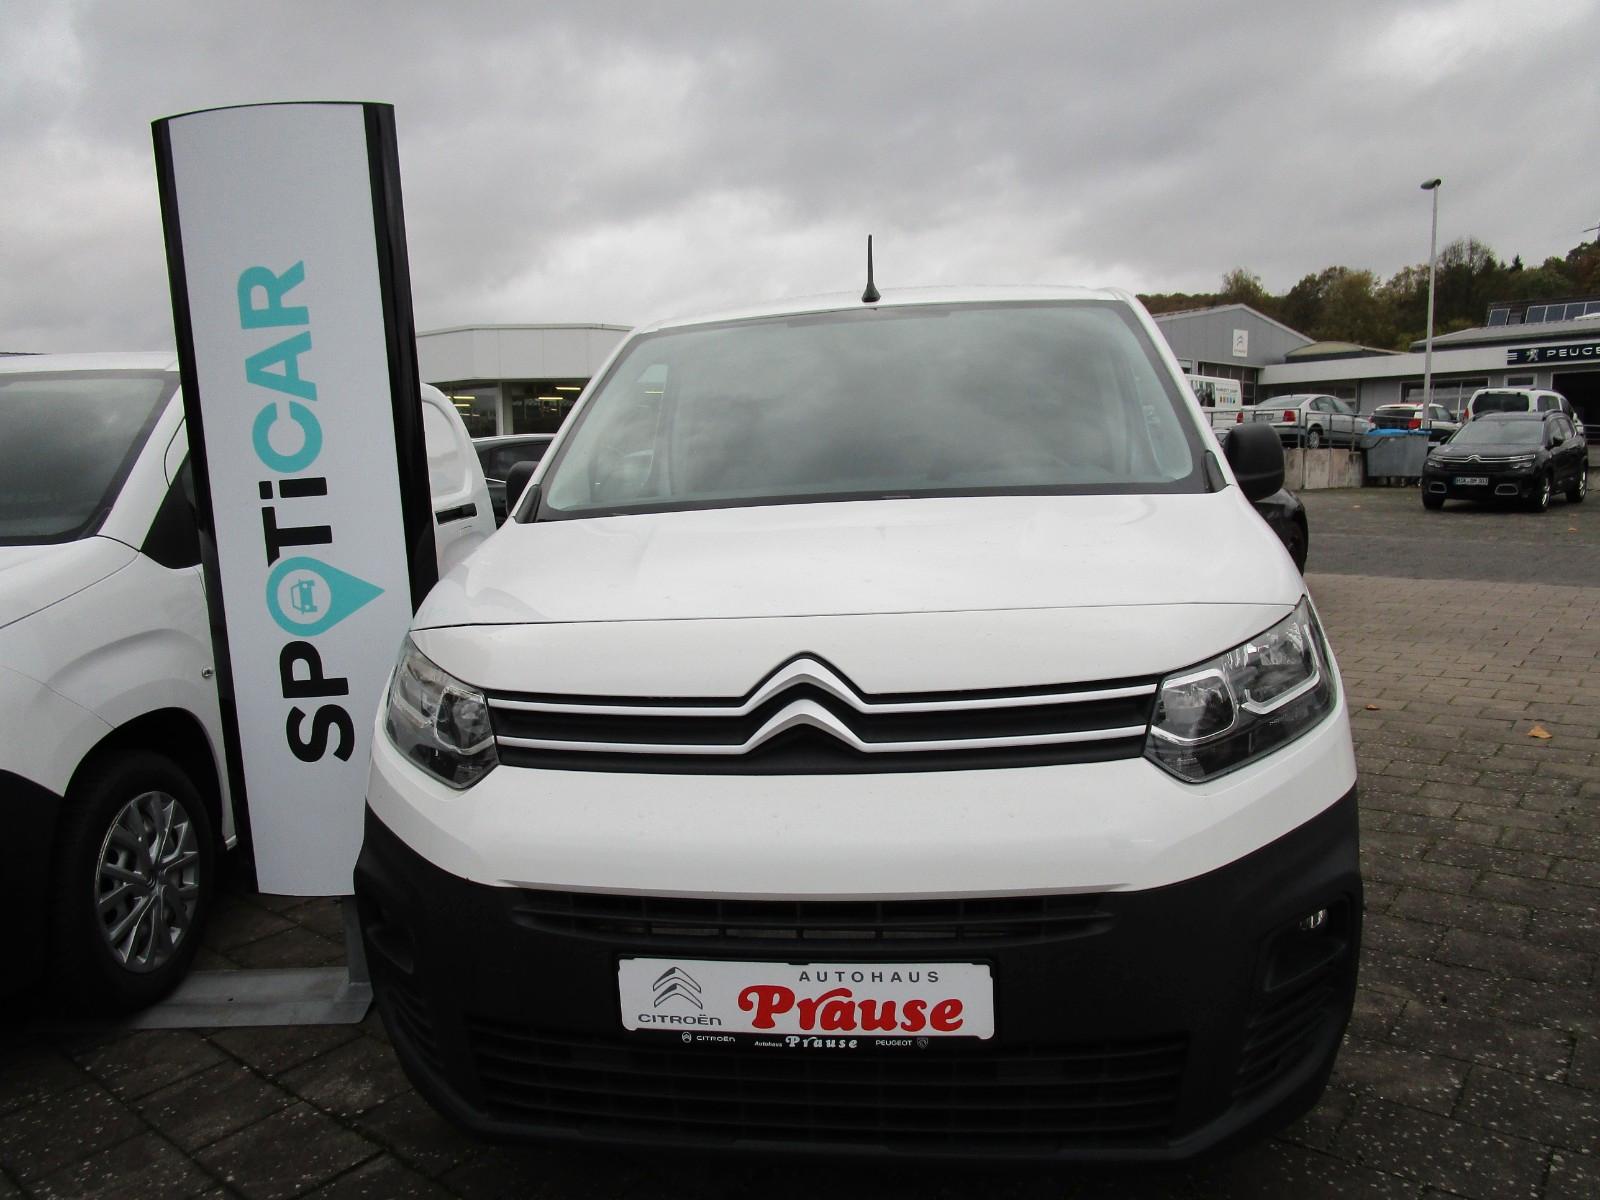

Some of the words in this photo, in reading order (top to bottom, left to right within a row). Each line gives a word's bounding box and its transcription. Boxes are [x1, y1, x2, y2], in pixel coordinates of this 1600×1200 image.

[799, 969, 940, 984] AUTOHAUS
[737, 984, 965, 1034] Prause
[785, 1035, 858, 1049] Prause
[875, 1038, 912, 1047] PEUGEOT
